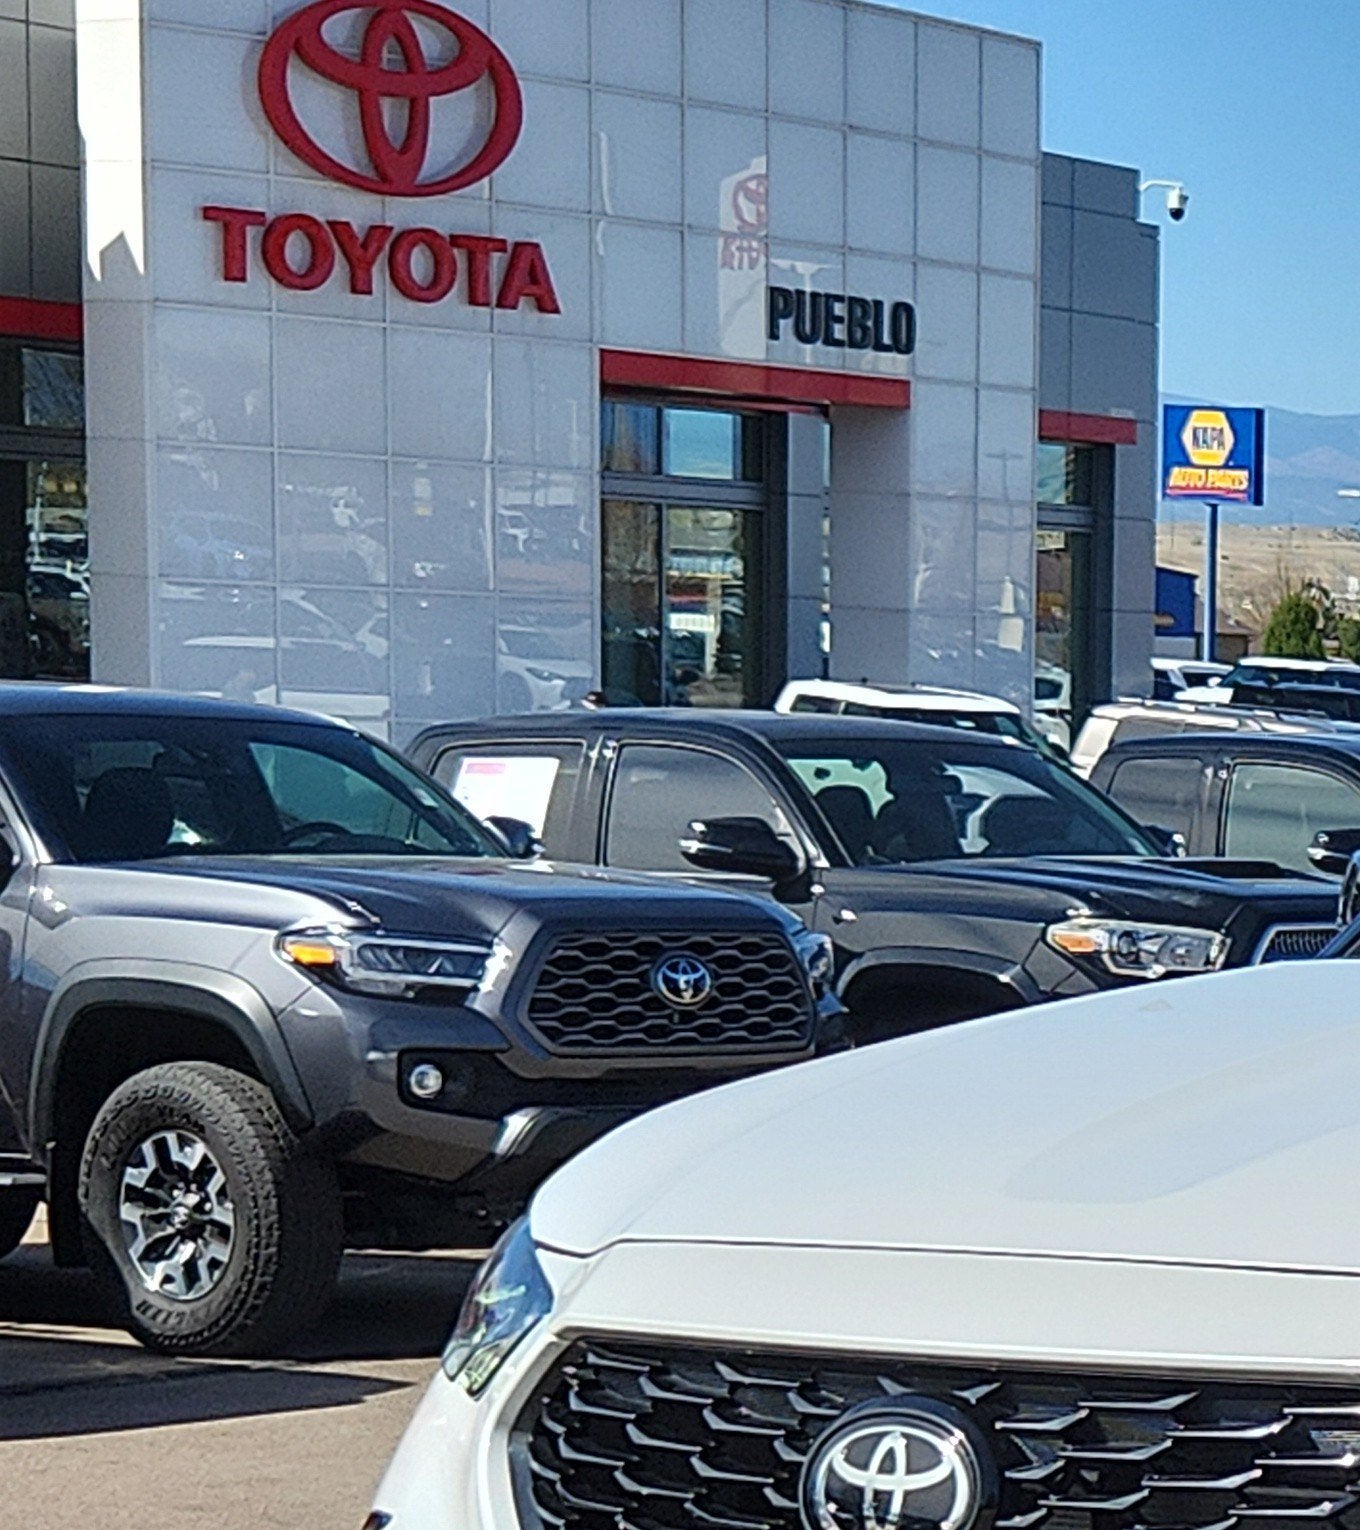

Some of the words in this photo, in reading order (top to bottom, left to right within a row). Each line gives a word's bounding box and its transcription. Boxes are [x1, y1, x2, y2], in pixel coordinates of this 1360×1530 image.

[203, 206, 561, 315] TOYOTA
[768, 285, 917, 355] PUEBLO
[1191, 426, 1226, 451] NAPA
[1168, 467, 1207, 489] AUTO
